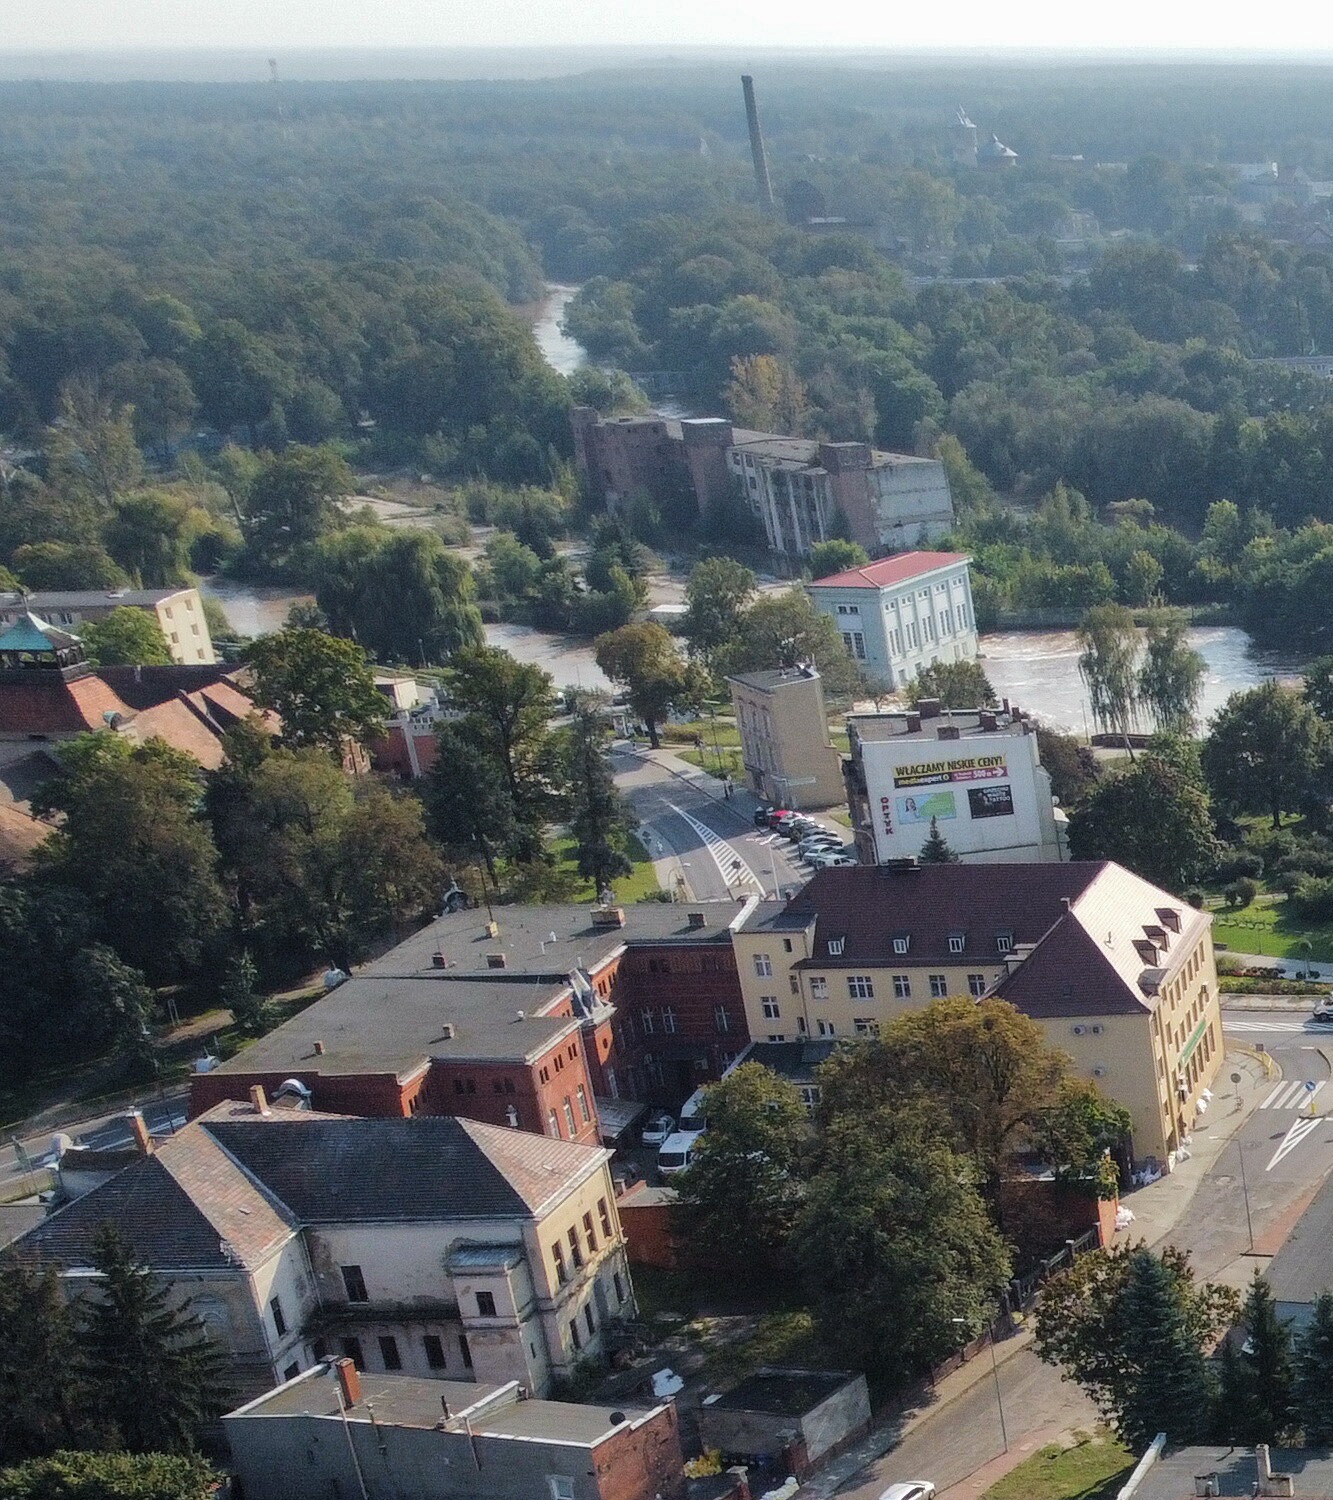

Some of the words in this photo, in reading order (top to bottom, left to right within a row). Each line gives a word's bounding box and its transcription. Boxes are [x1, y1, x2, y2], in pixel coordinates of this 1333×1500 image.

[947, 758, 976, 771] NISKIE
[977, 756, 1003, 767] CENY!
[880, 796, 894, 835] OPTYK
